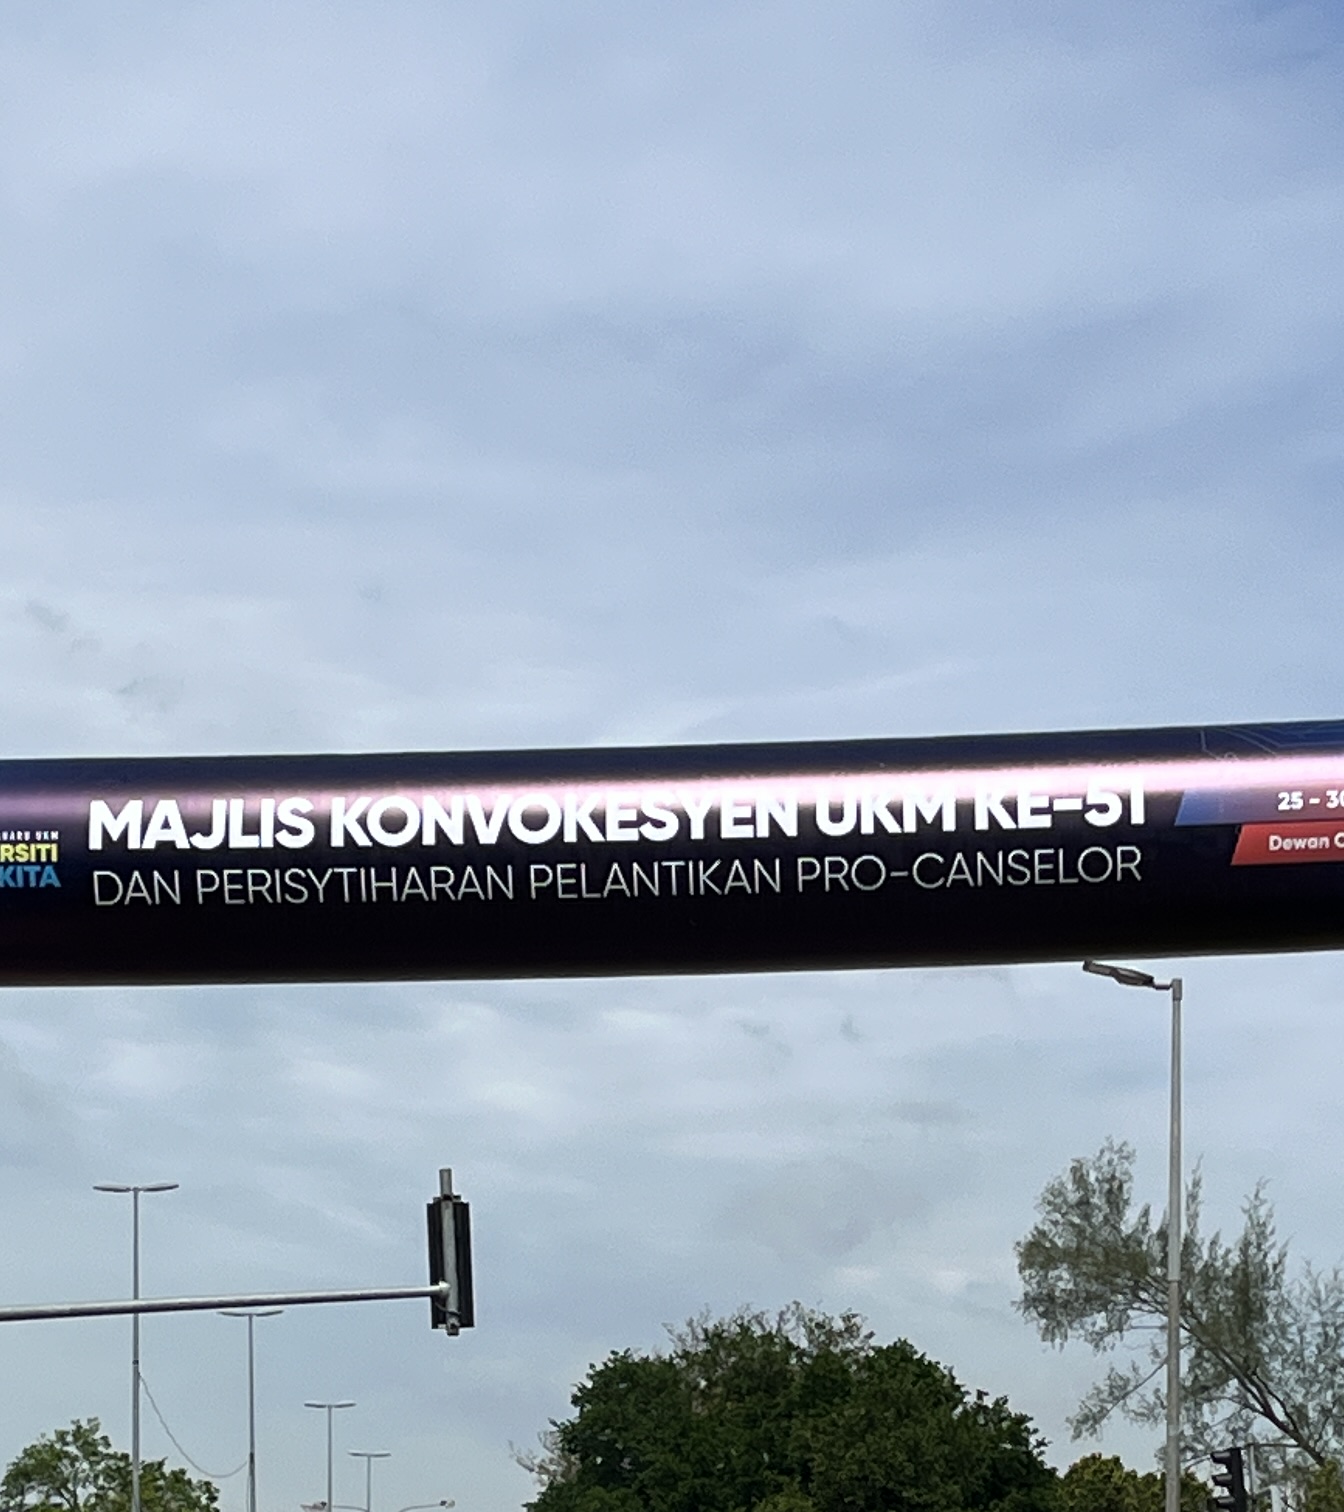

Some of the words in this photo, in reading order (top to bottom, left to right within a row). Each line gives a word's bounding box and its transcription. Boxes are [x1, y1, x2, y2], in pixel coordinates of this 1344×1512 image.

[87, 797, 316, 851] MAJLIS
[329, 786, 798, 849] KONVOKESYEN
[814, 784, 956, 837] UKM
[974, 774, 1145, 831] KE-51
[1277, 791, 1304, 811] 25
[1268, 834, 1330, 851] Dewan
[93, 869, 180, 905] DAN
[196, 864, 514, 904] PERISYTIHARAN
[530, 858, 780, 900] PELANTIKAN
[796, 846, 1142, 894] PRO-CANSELOR
